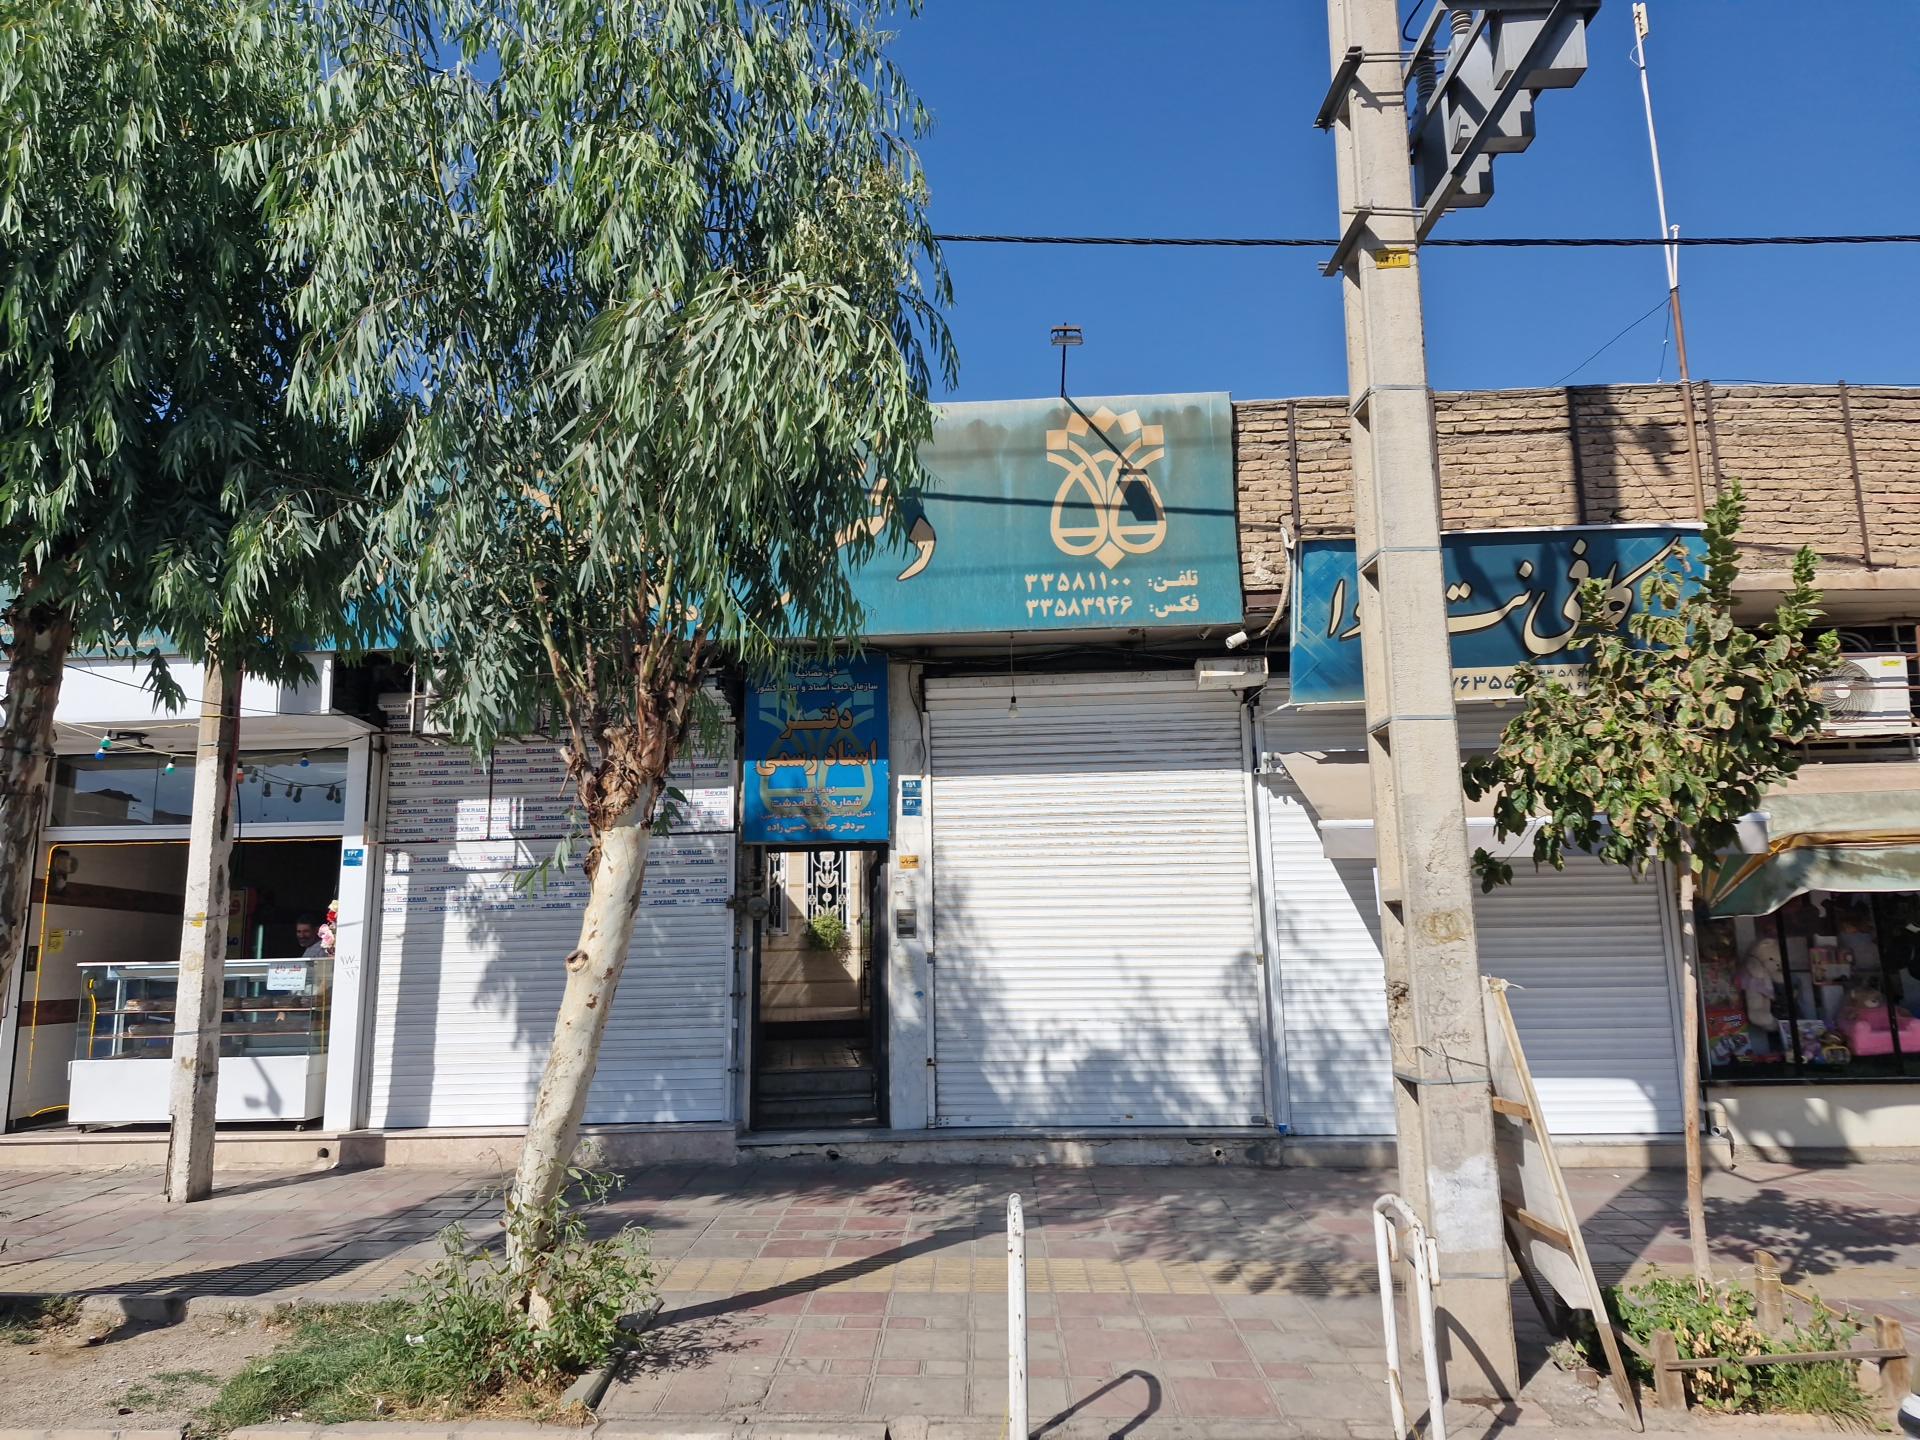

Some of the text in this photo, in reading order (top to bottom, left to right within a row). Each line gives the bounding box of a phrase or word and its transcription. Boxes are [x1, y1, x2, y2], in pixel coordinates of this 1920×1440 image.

[1024, 569, 1198, 592] تلفن: ۳۳۵۸۱۱۰۰
[1026, 593, 1199, 618] فکس: ۳۳۵۸۳۹۴۶
[779, 700, 853, 740] دفتر
[756, 738, 878, 776] اسناد رسمی
